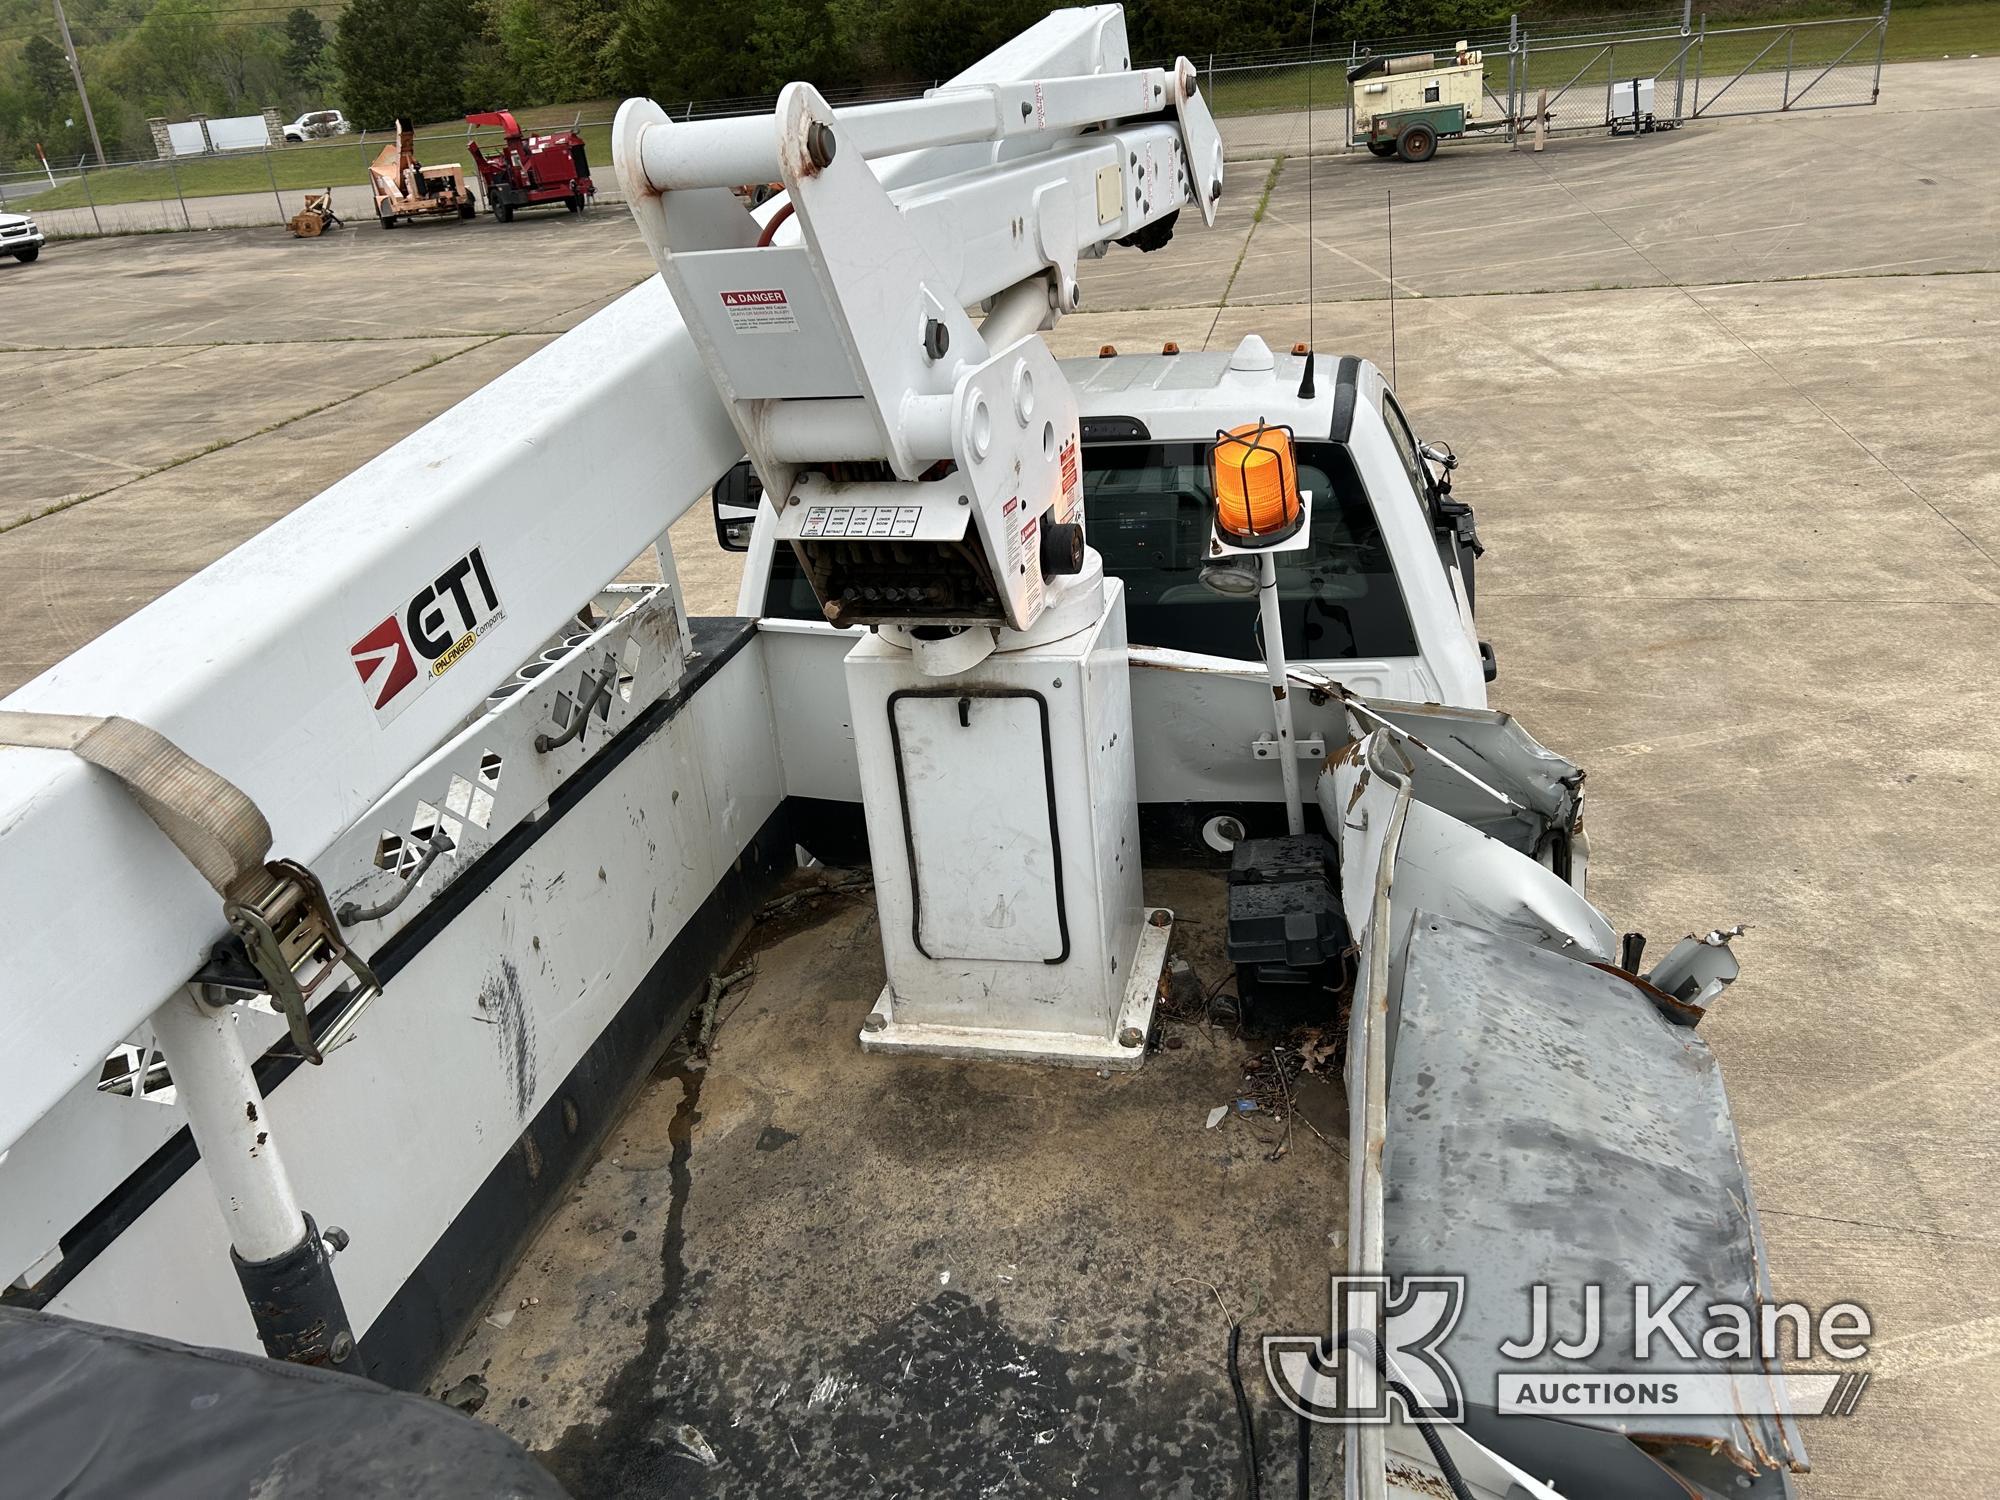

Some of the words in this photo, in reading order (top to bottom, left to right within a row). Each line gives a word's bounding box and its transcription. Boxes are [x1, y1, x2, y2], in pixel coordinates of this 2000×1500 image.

[738, 292, 783, 303] DANGER
[406, 547, 498, 660] ETI
[428, 670, 434, 680] A
[434, 634, 474, 673] PALFINGER
[475, 610, 506, 638] Company
